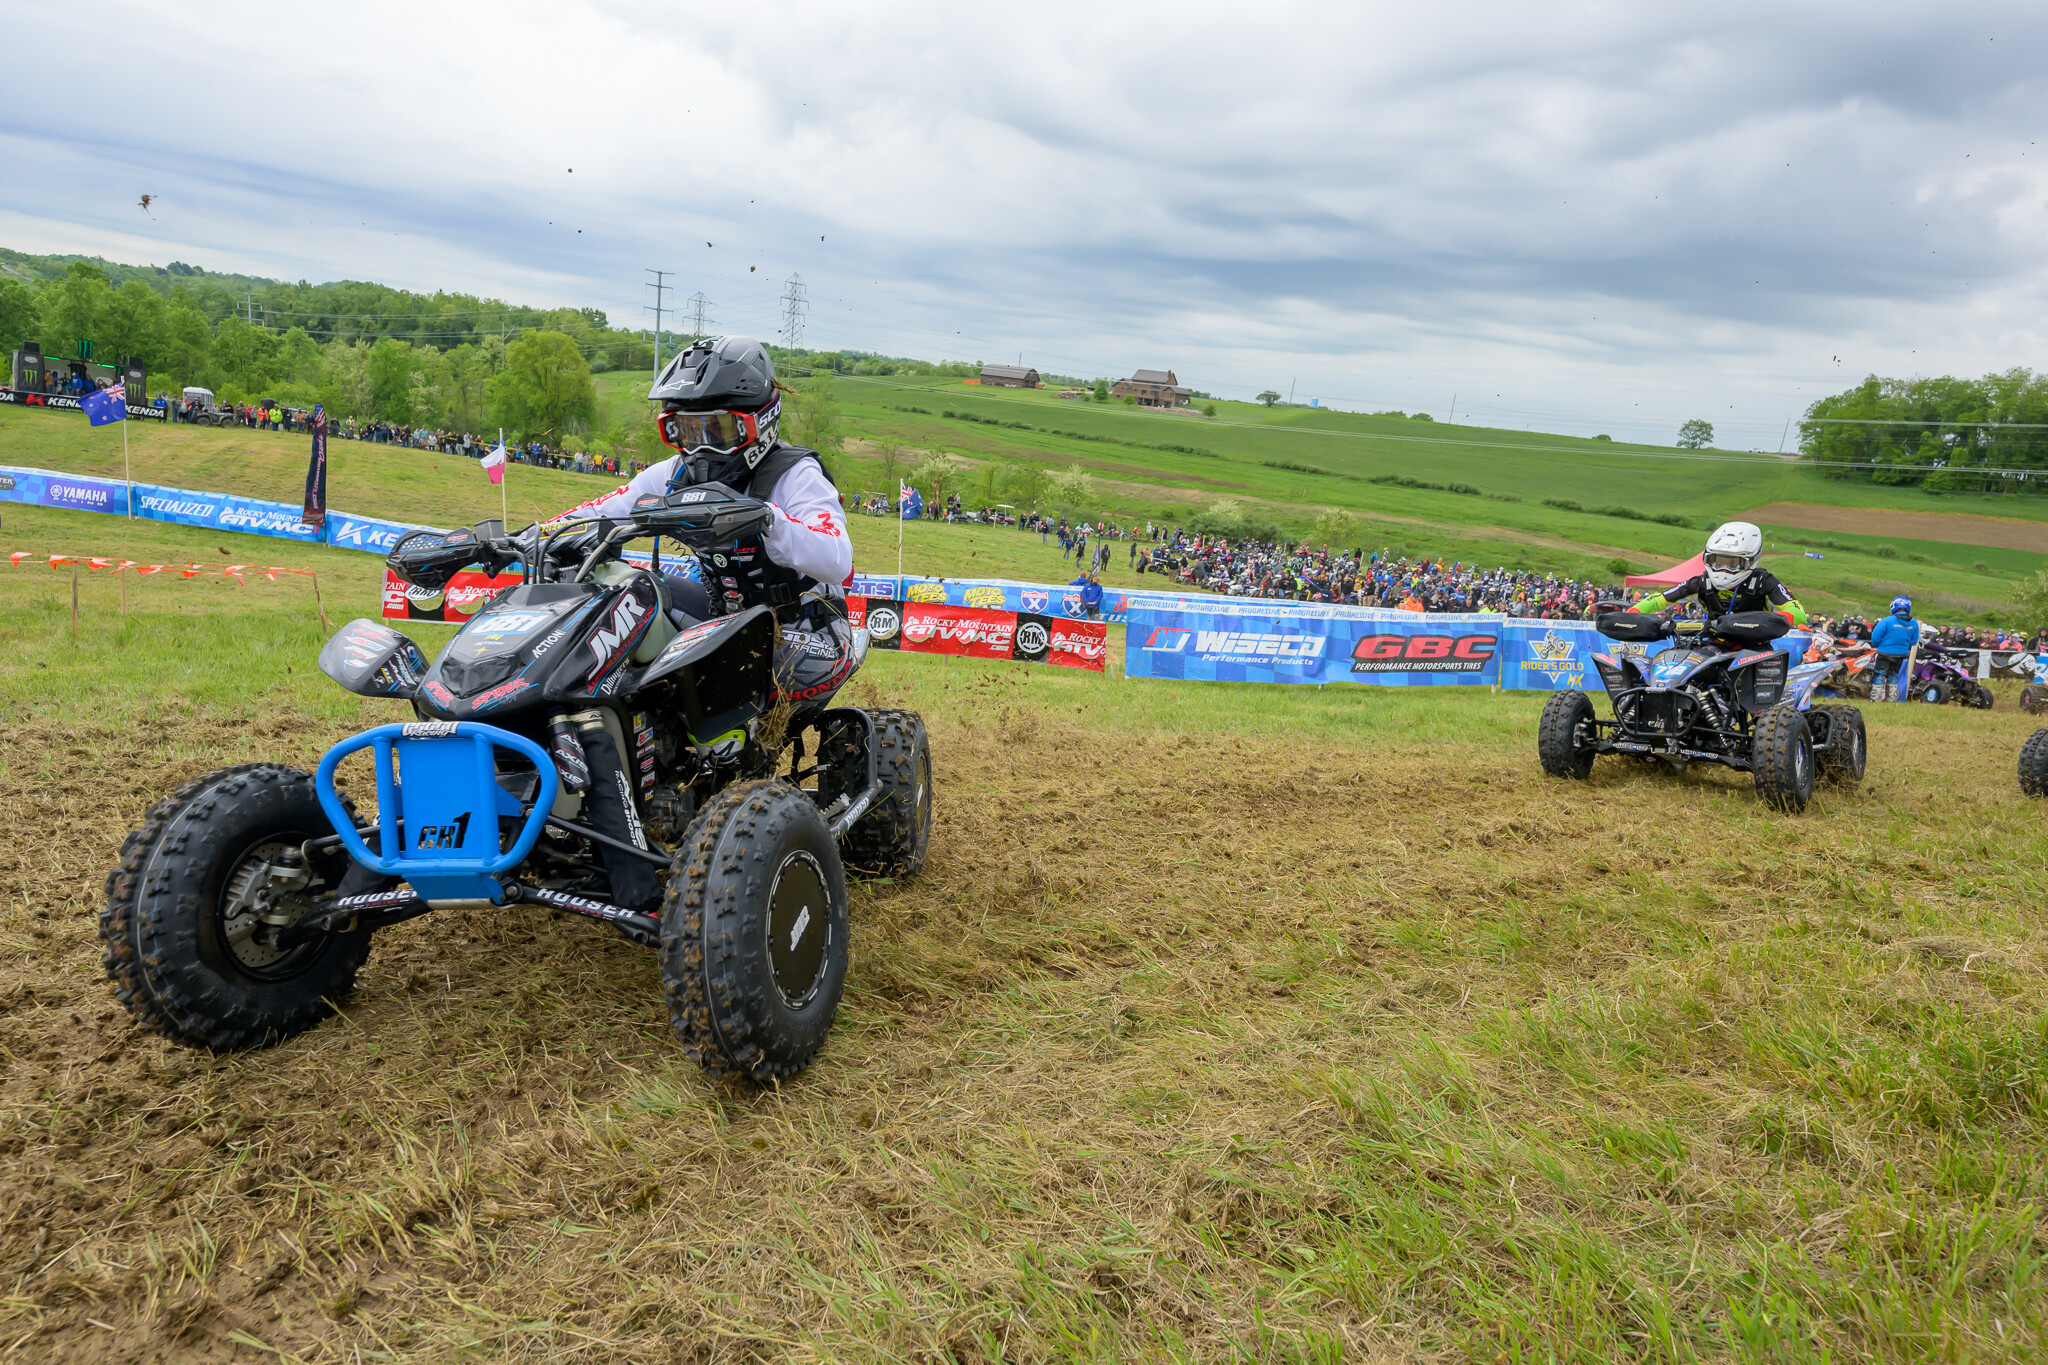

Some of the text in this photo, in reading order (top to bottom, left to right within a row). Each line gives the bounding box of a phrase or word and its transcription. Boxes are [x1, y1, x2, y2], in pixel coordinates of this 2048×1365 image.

[125, 404, 164, 418] KENDA
[63, 486, 108, 503] YAMAHA
[680, 491, 707, 503] 881
[53, 497, 104, 506] RACING
[139, 495, 214, 518] SPECIALIZED
[236, 507, 304, 524] ROCKY MOUNTA
[464, 585, 498, 597] ROCKY
[907, 583, 944, 598] MOTO
[963, 586, 1002, 604] MOTO
[913, 592, 948, 605] TEES
[969, 595, 1007, 608] TEES
[1028, 598, 1042, 610] X
[1132, 599, 1179, 609] PROGRESSIVE
[1069, 601, 1083, 614] X
[1186, 603, 1231, 613] PROGRESSIVE
[1238, 607, 1281, 616] PROGRESSIVE
[1288, 609, 1330, 618] PROGRESSIVE
[1335, 611, 1375, 620] PROGRESSIVE
[1380, 613, 1419, 621] PROGRESSIVE
[470, 614, 550, 634] 881
[873, 616, 892, 629] RM
[922, 615, 1013, 633] ROCKY MOUNTAIN
[588, 593, 647, 681] JMR
[1068, 632, 1101, 645] ROCKY
[1354, 636, 1497, 659] GBC
[1201, 653, 1313, 667] Performance Products
[1738, 651, 1774, 665] KENDA
[1355, 662, 1482, 671] PERFORMANCE MOTORSPORTS TIRES
[1521, 660, 1584, 671] RIDER'S GOLD
[785, 659, 853, 702] HONDA
[1567, 672, 1585, 688] MX
[471, 677, 530, 710] SPIDER
[555, 749, 589, 772] AXIS
[536, 888, 636, 918] HOUSER
